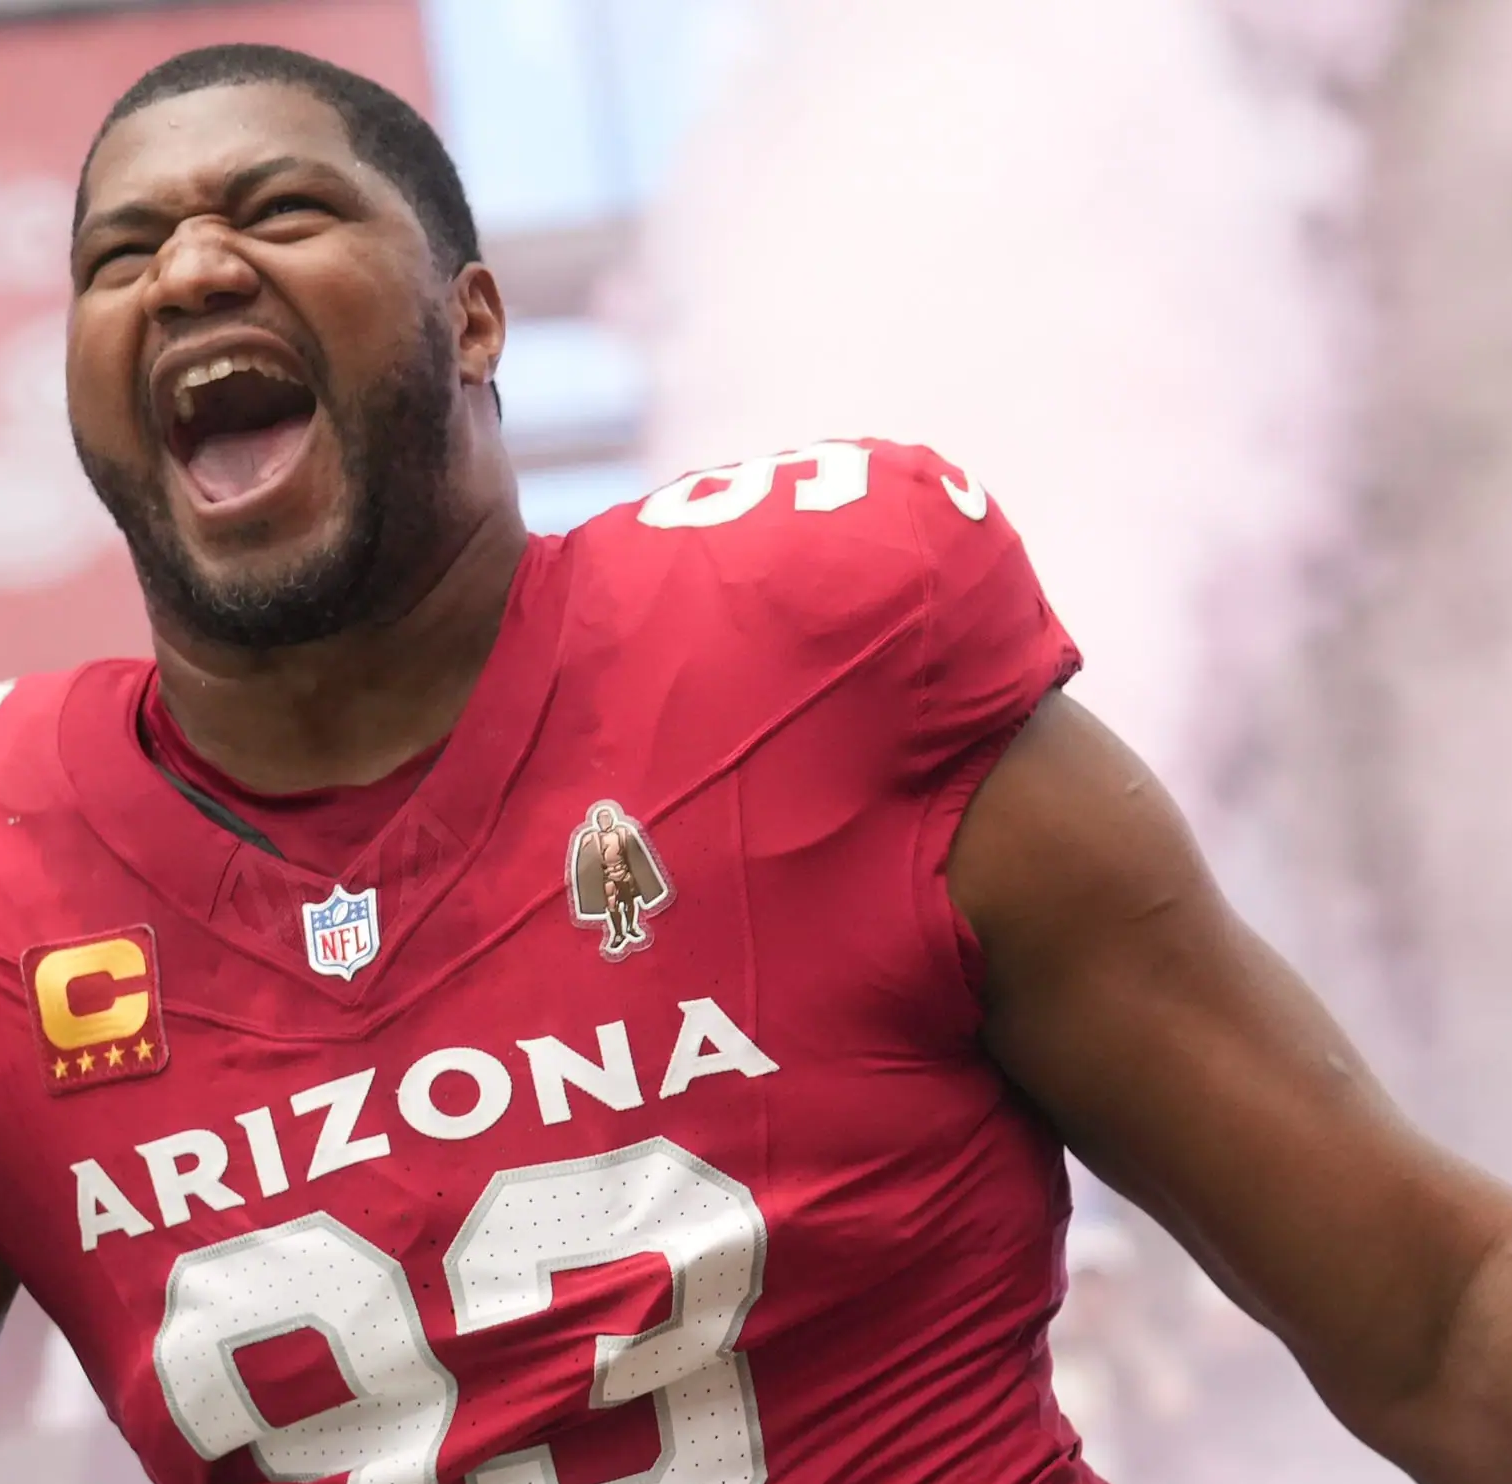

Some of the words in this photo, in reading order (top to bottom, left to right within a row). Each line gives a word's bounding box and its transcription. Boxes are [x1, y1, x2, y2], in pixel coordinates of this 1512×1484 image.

[35, 937, 149, 1050] C
[319, 926, 367, 961] NFL
[69, 996, 780, 1252] ARIZONA
